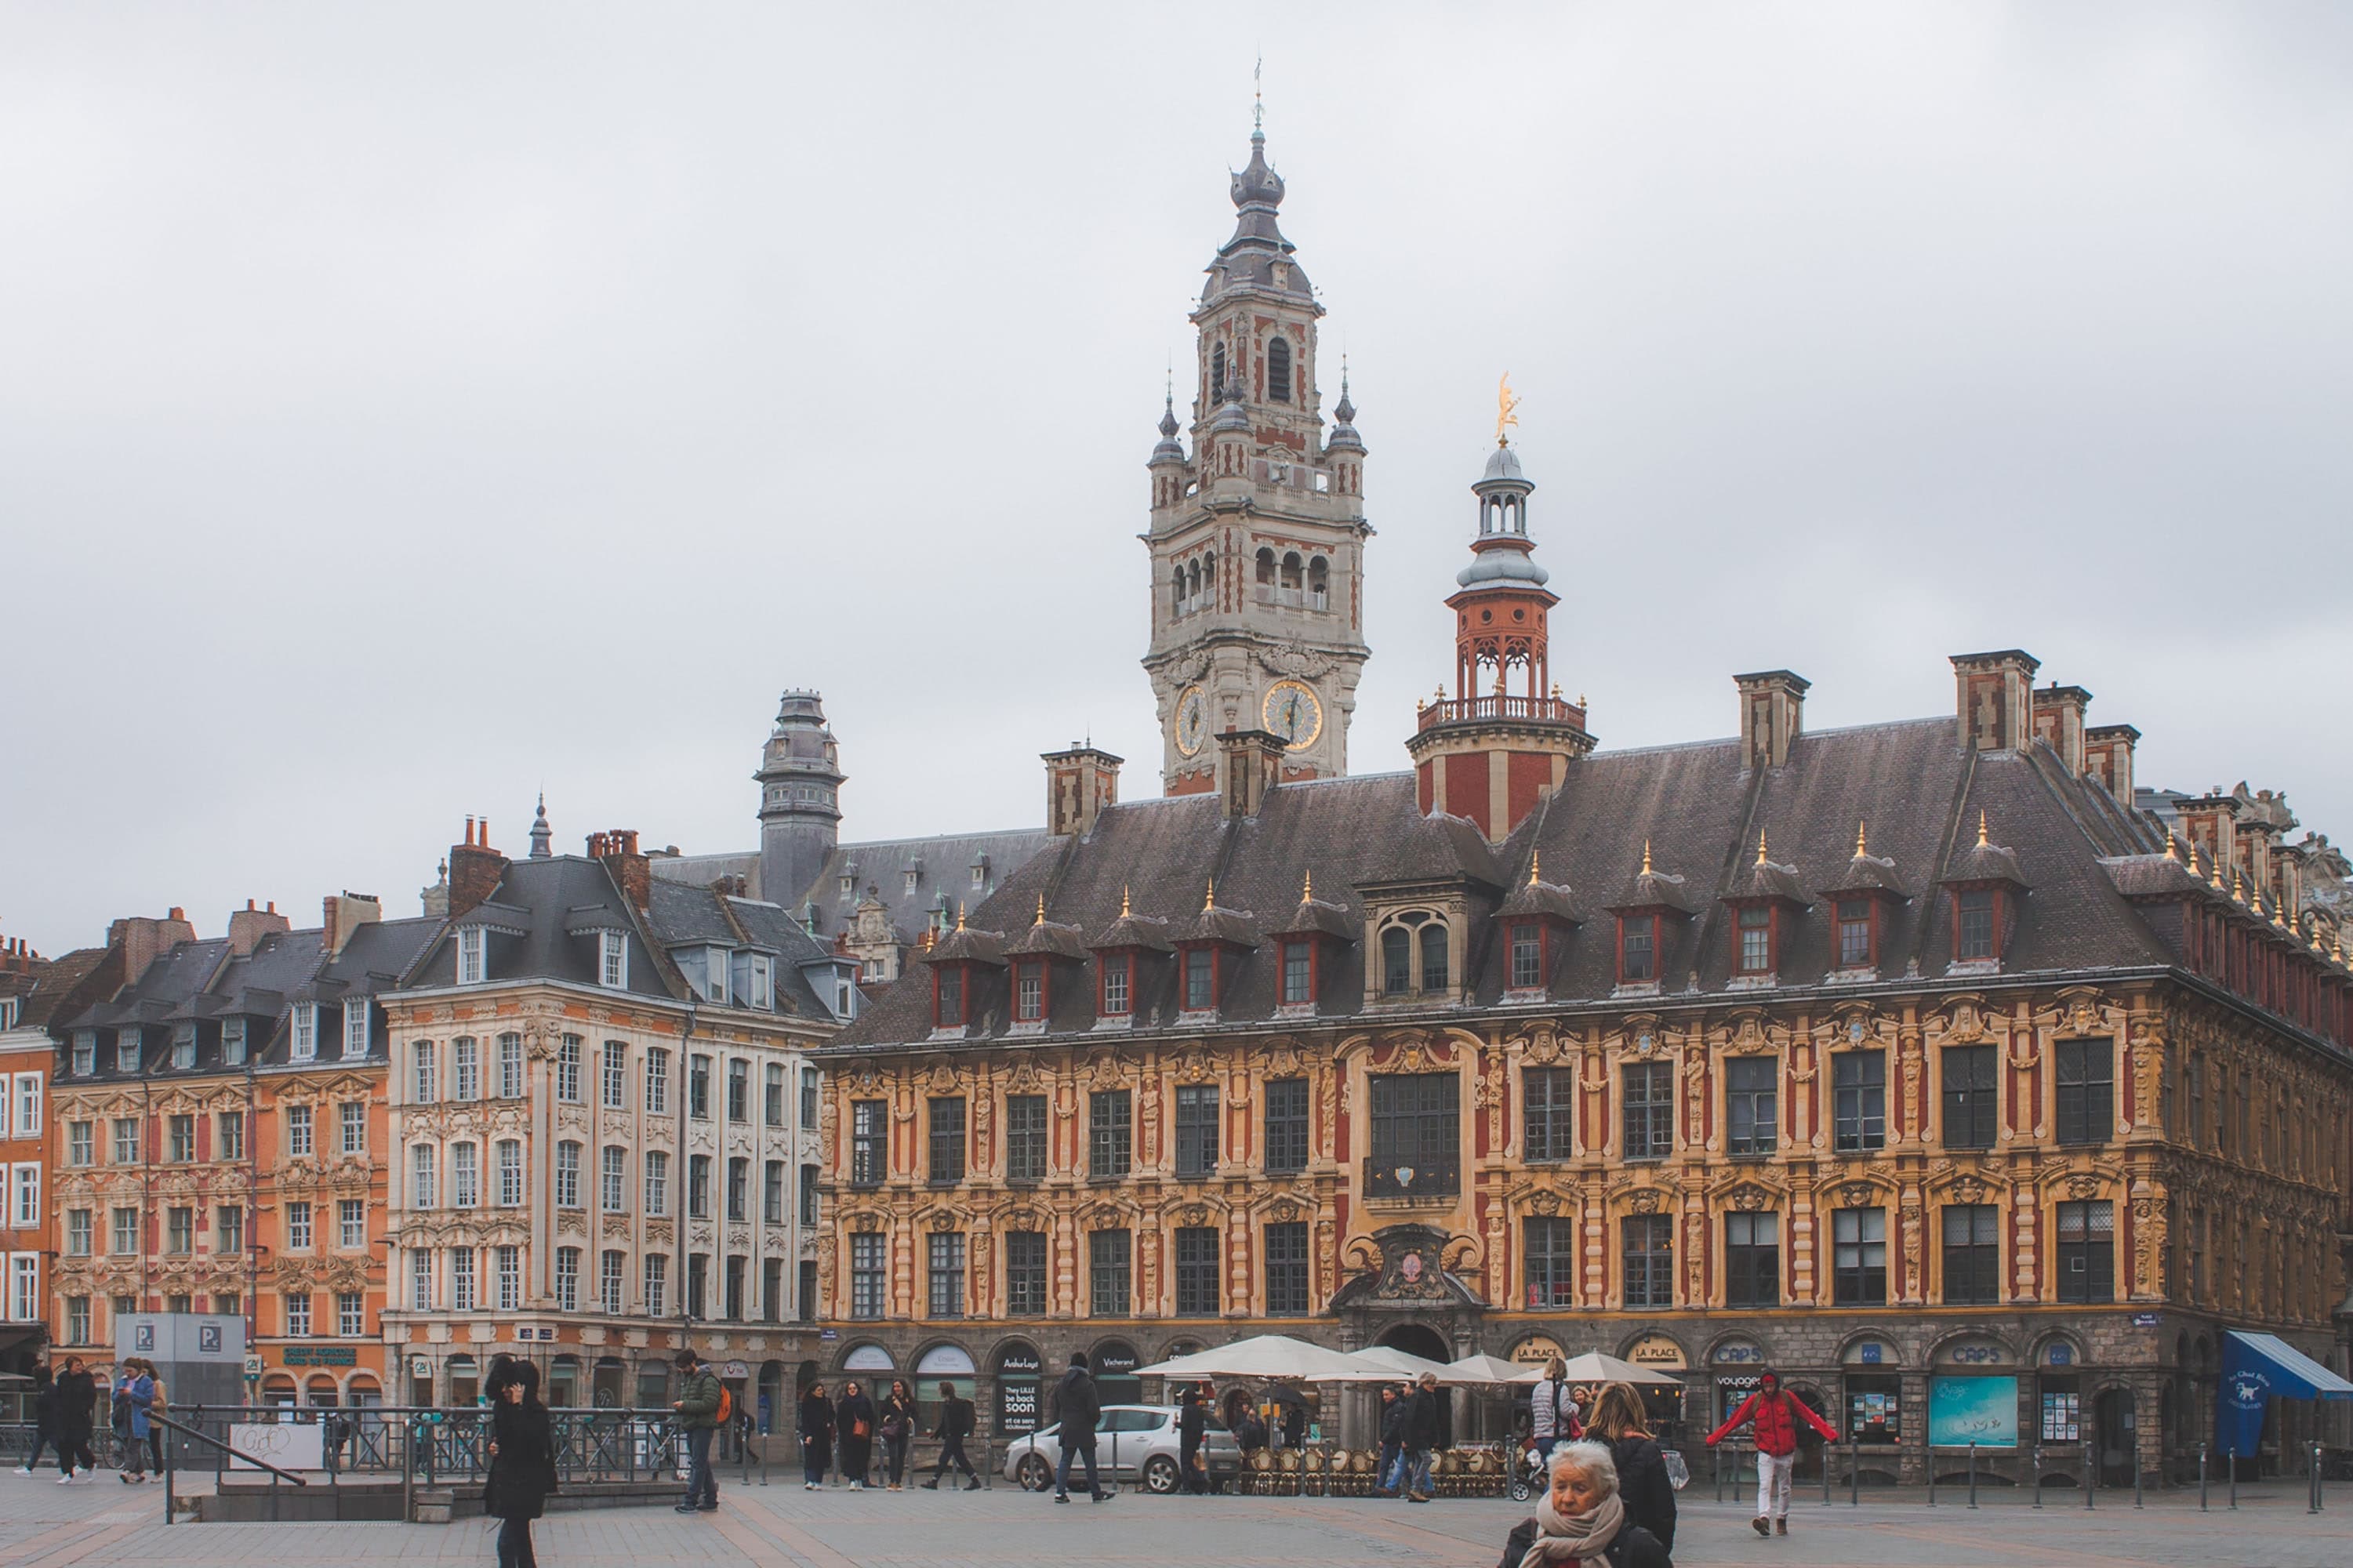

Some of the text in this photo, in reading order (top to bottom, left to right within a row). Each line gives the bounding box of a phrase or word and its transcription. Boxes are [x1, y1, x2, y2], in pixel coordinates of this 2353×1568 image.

[1518, 1348, 1558, 1357] LA PLACE
[1636, 1348, 1678, 1357] LA PLACE
[323, 1357, 357, 1366] FRANCE
[1103, 1358, 1135, 1367] Vacherand
[1005, 1386, 1019, 1395] They
[1016, 1394, 1035, 1403] back
[1005, 1403, 1035, 1412] soon
